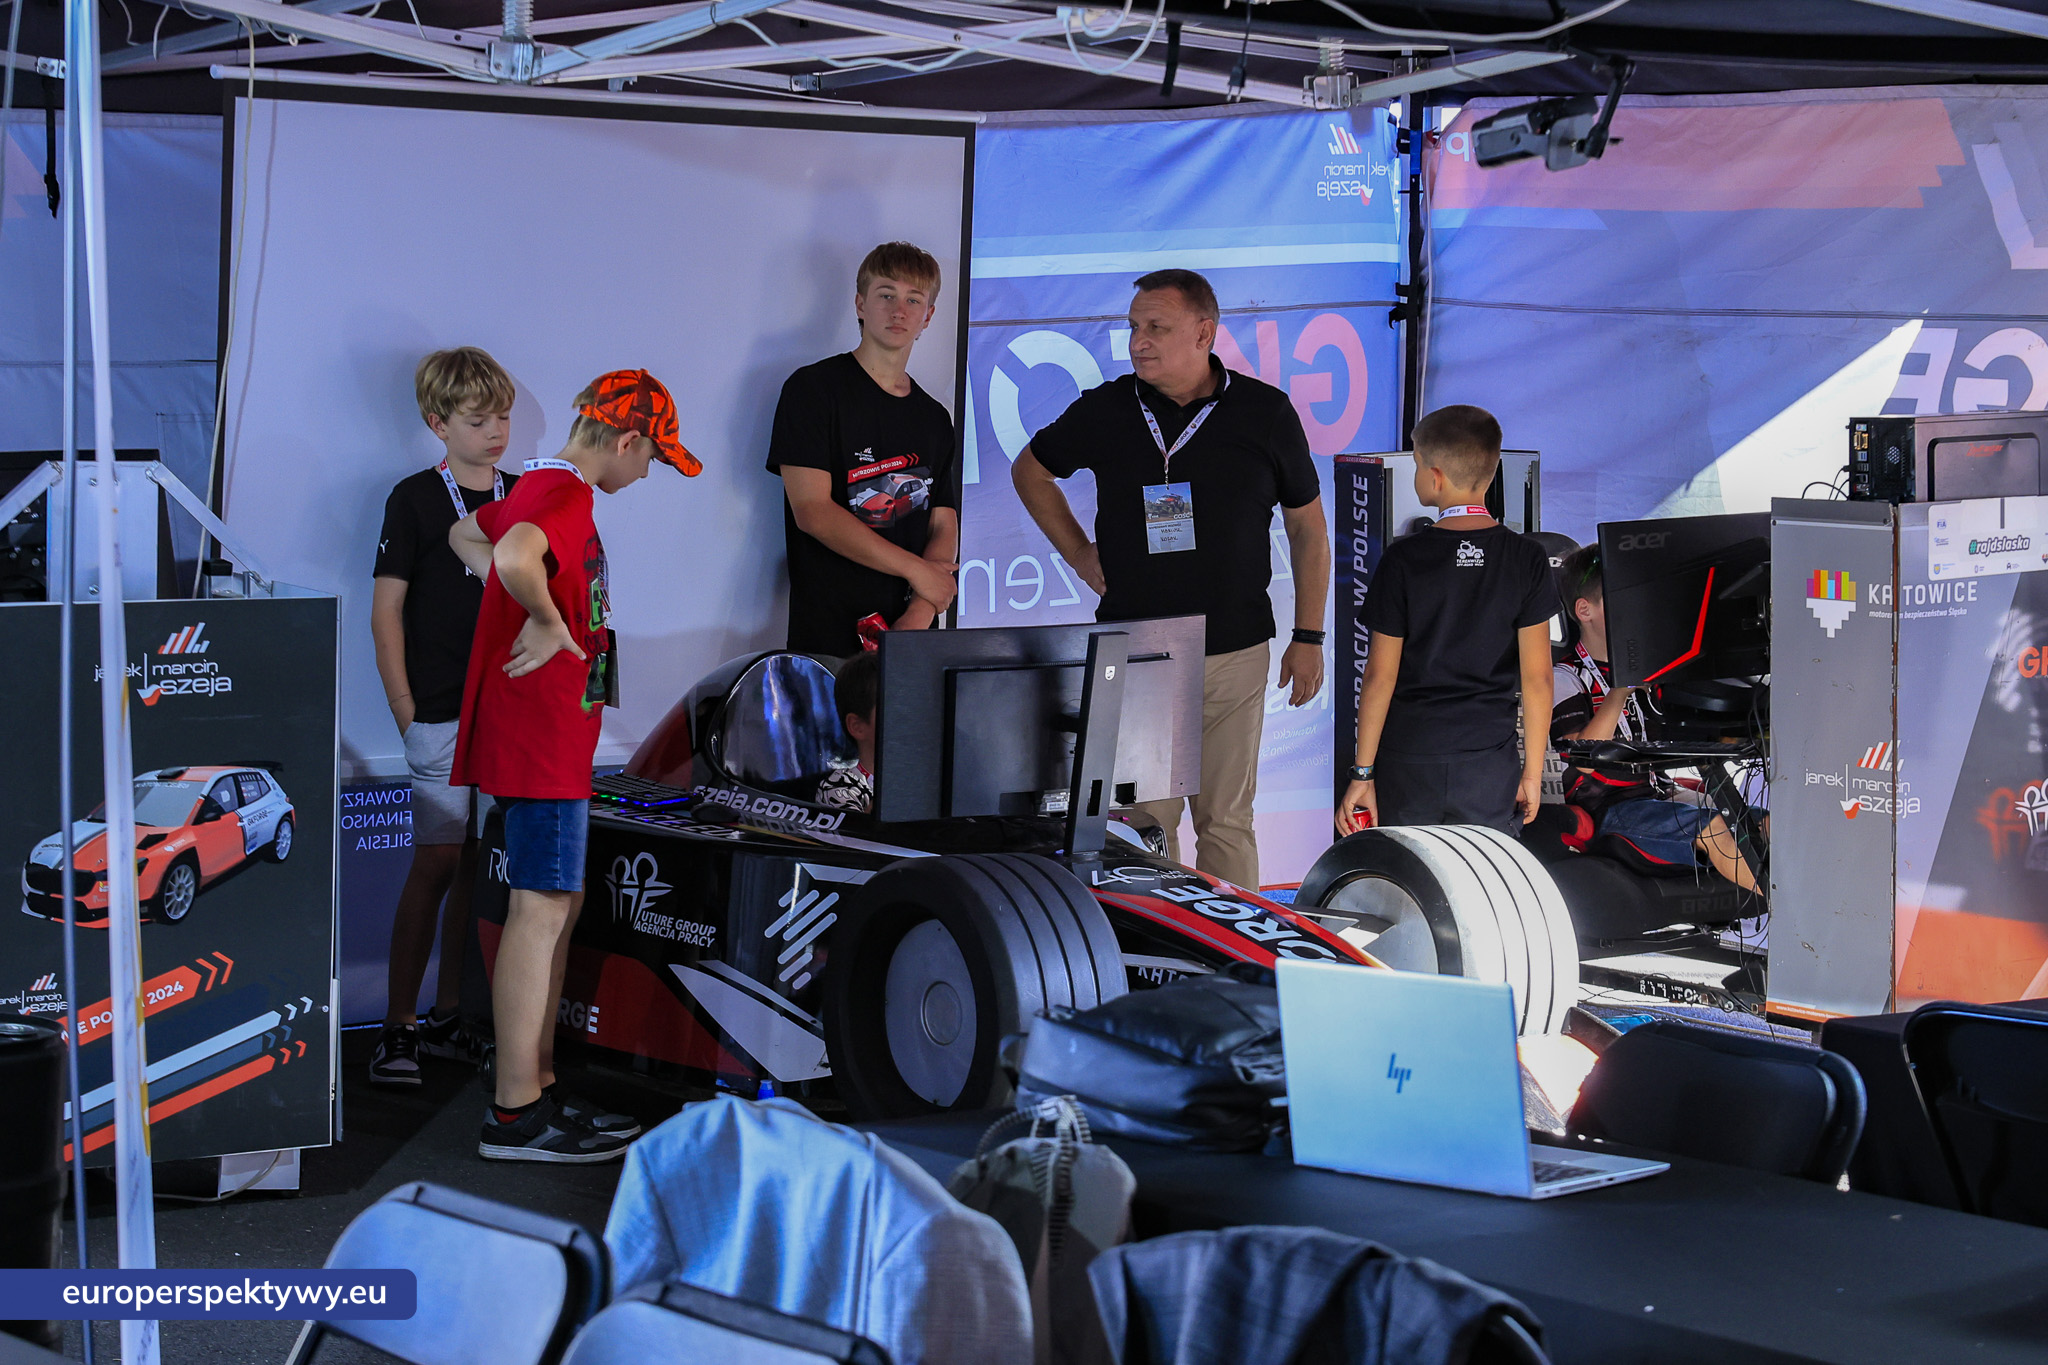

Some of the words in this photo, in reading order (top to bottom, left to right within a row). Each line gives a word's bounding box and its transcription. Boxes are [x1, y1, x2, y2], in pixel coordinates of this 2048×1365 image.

[1353, 473, 1368, 574] POLSCE
[1619, 531, 1672, 550] acer
[1969, 535, 2030, 557] #rajdslaska
[1868, 581, 1978, 606] KATOWICE
[152, 659, 219, 677] marcin
[159, 672, 232, 697] szeja
[1804, 768, 1845, 787] jarek
[1852, 779, 1911, 794] marcin
[1858, 792, 1921, 819] szeja
[634, 920, 675, 940] AGENCJA
[677, 931, 715, 948] PRACY
[675, 919, 717, 937] GROUP
[146, 980, 185, 1005] 2024
[1387, 1052, 1411, 1094] hp
